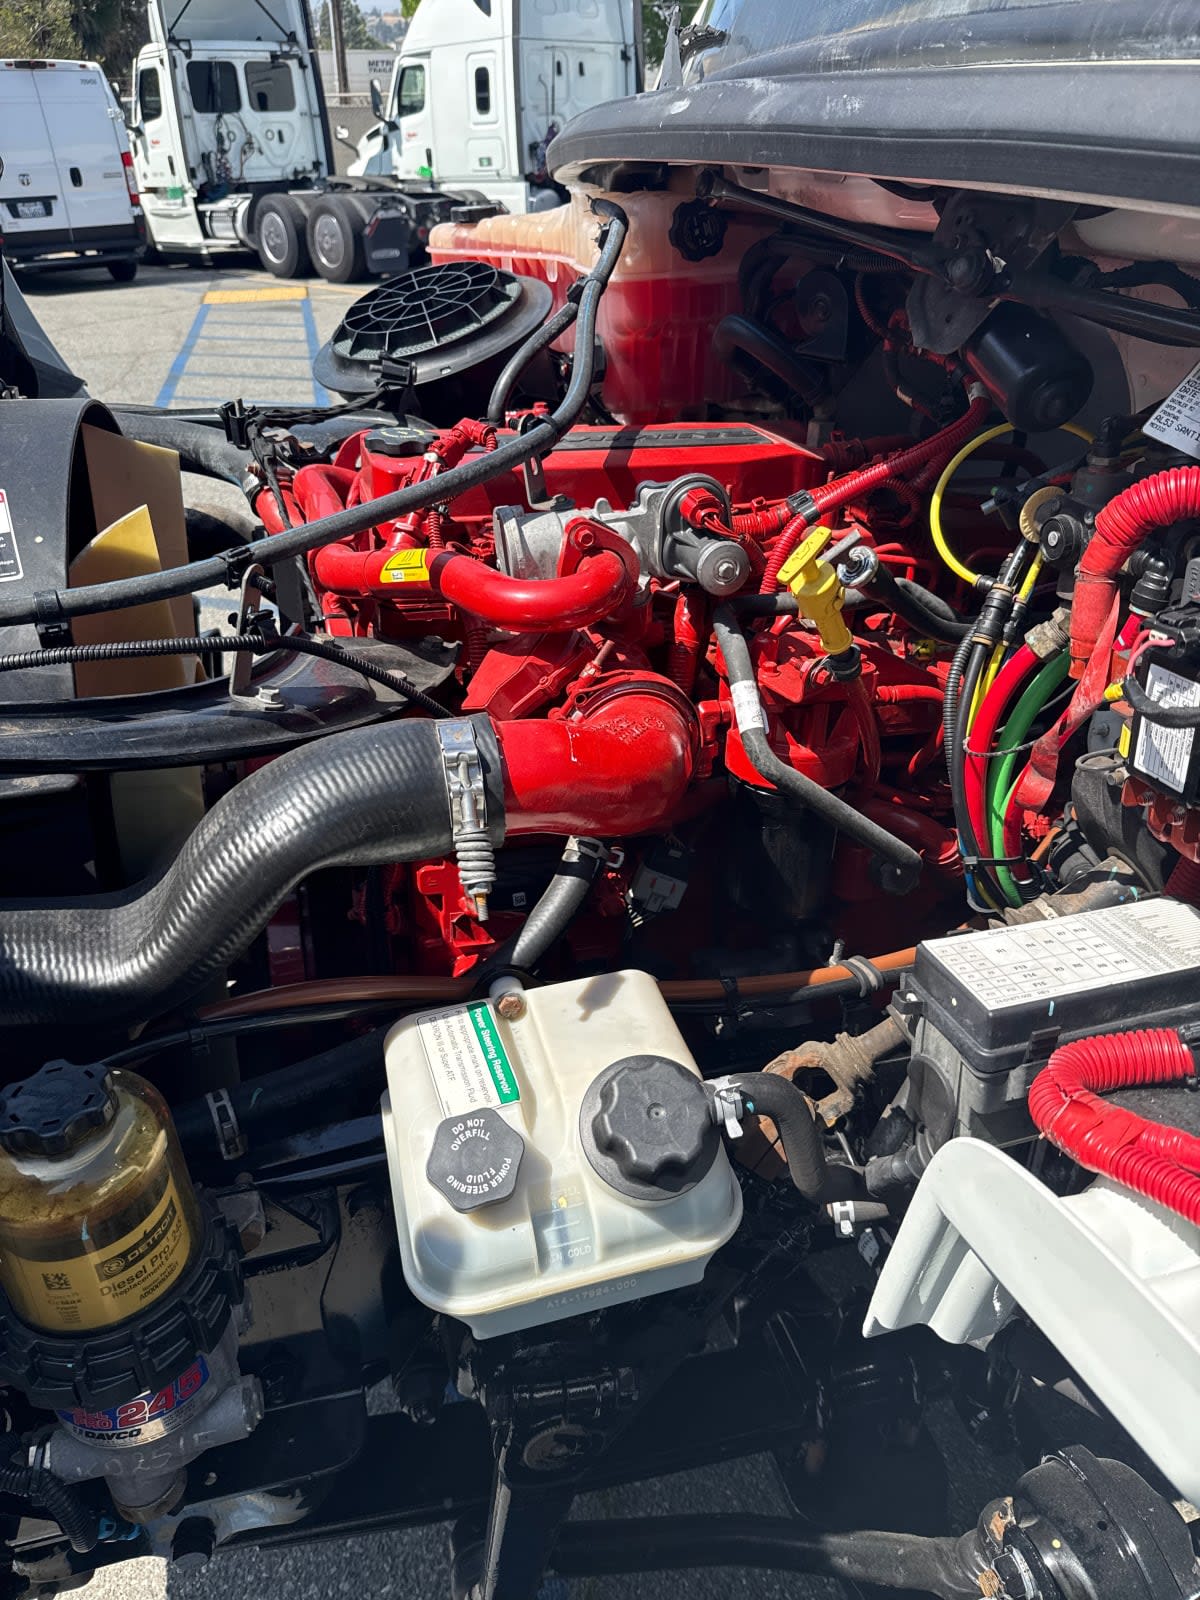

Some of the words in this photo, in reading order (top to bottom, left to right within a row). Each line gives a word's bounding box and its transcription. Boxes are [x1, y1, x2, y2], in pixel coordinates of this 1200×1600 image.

[459, 1024, 475, 1054] appropriate
[440, 1052, 452, 1071] Super
[471, 1054, 480, 1070] mark
[474, 1008, 486, 1029] Power
[480, 1029, 498, 1060] Steering
[491, 1059, 512, 1095] Reservoir
[446, 1024, 459, 1051] Automatic
[455, 1050, 471, 1088] Transmission
[468, 1087, 478, 1104] Fluid
[475, 1069, 483, 1077] on
[451, 1122, 465, 1135] DO
[467, 1119, 485, 1128] NOT
[451, 1129, 490, 1151] OVERFILL
[466, 1167, 496, 1184] FLUID
[489, 1157, 512, 1188] POWER
[446, 1175, 489, 1195] STEERING
[127, 1206, 173, 1261] DETROIT
[568, 1245, 592, 1258] COLD
[100, 1265, 148, 1297] Diesel
[150, 1244, 170, 1267] Pro
[112, 1260, 165, 1299] Replacement
[116, 1360, 204, 1429] 245
[74, 1414, 113, 1430] PRO
[84, 1428, 143, 1441] DAYCO
